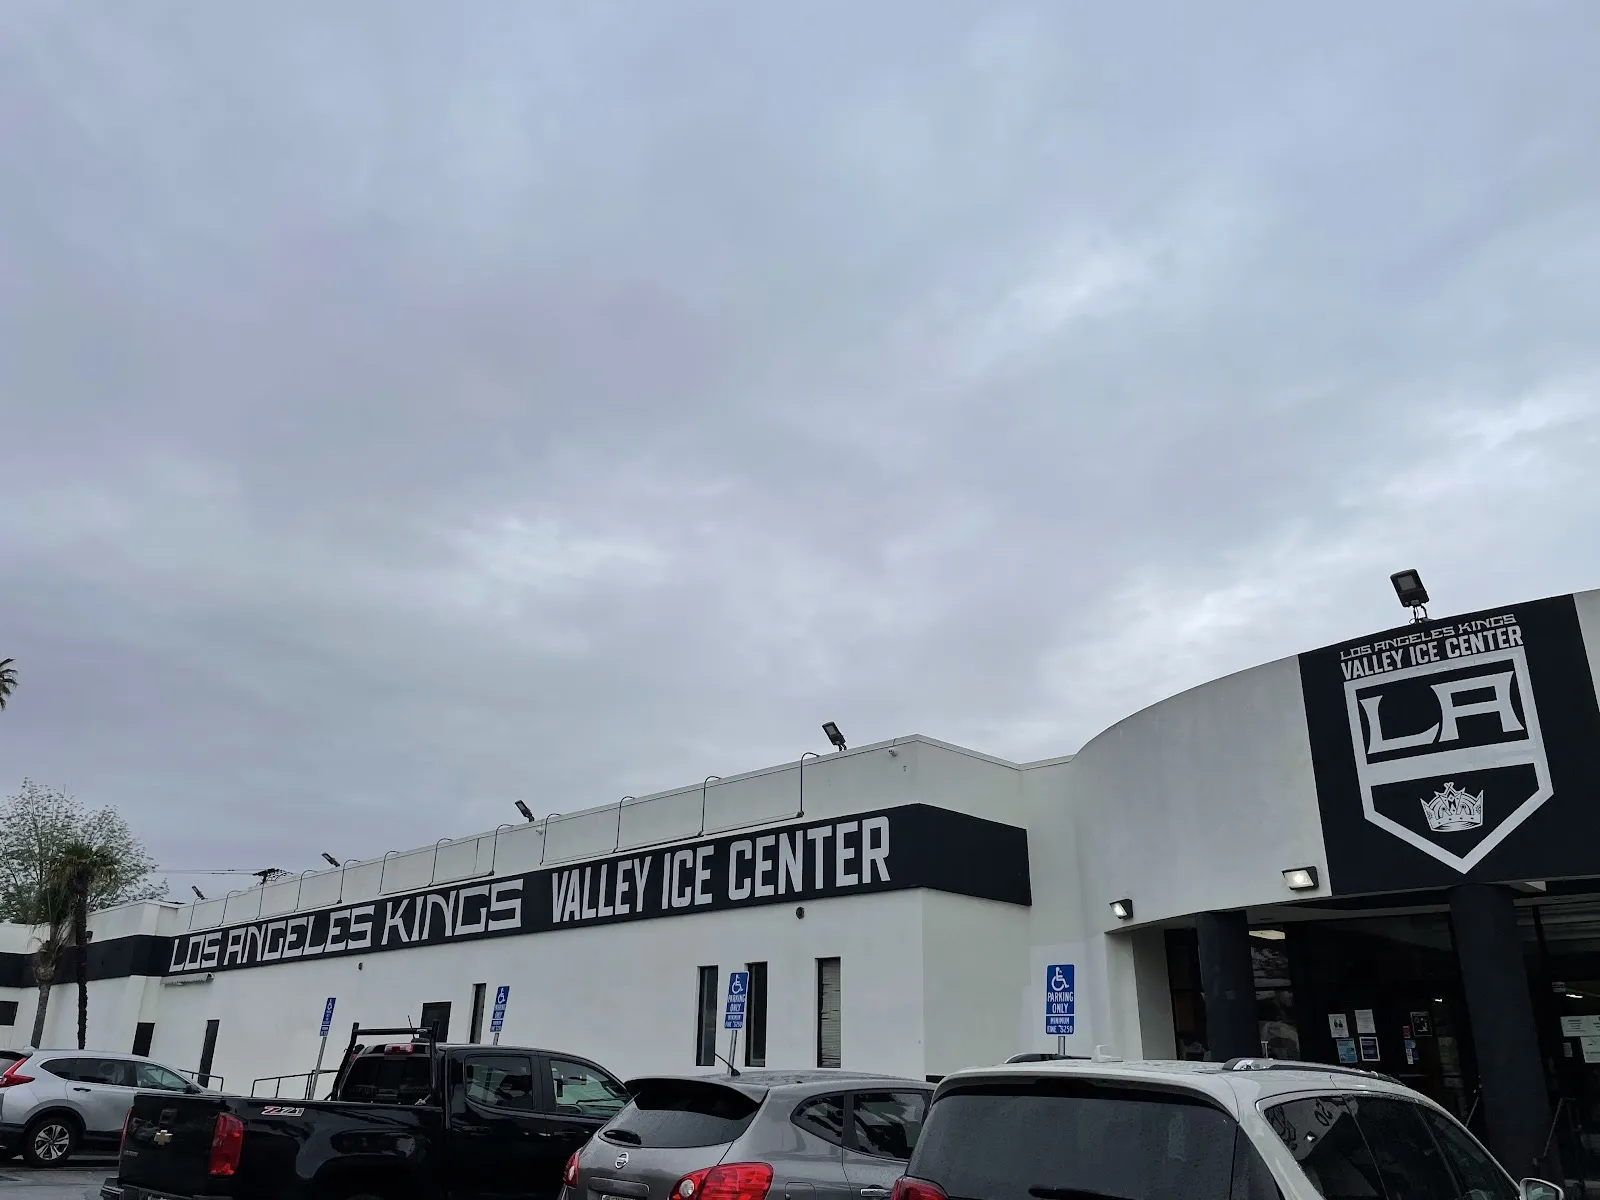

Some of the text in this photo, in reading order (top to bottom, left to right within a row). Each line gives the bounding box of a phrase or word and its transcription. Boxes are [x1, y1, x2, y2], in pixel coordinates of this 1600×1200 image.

[1340, 613, 1517, 661] LOS ANGELES KINGS
[1340, 625, 1524, 681] VALLEY ICE CENTER
[1359, 670, 1525, 754] LA
[169, 816, 891, 972] LOS ANGELES KINGS VALLEY ICE CENTER
[1047, 992, 1074, 1002] PARKING
[1052, 1003, 1069, 1013] ONLY
[261, 1105, 306, 1117] Z71
